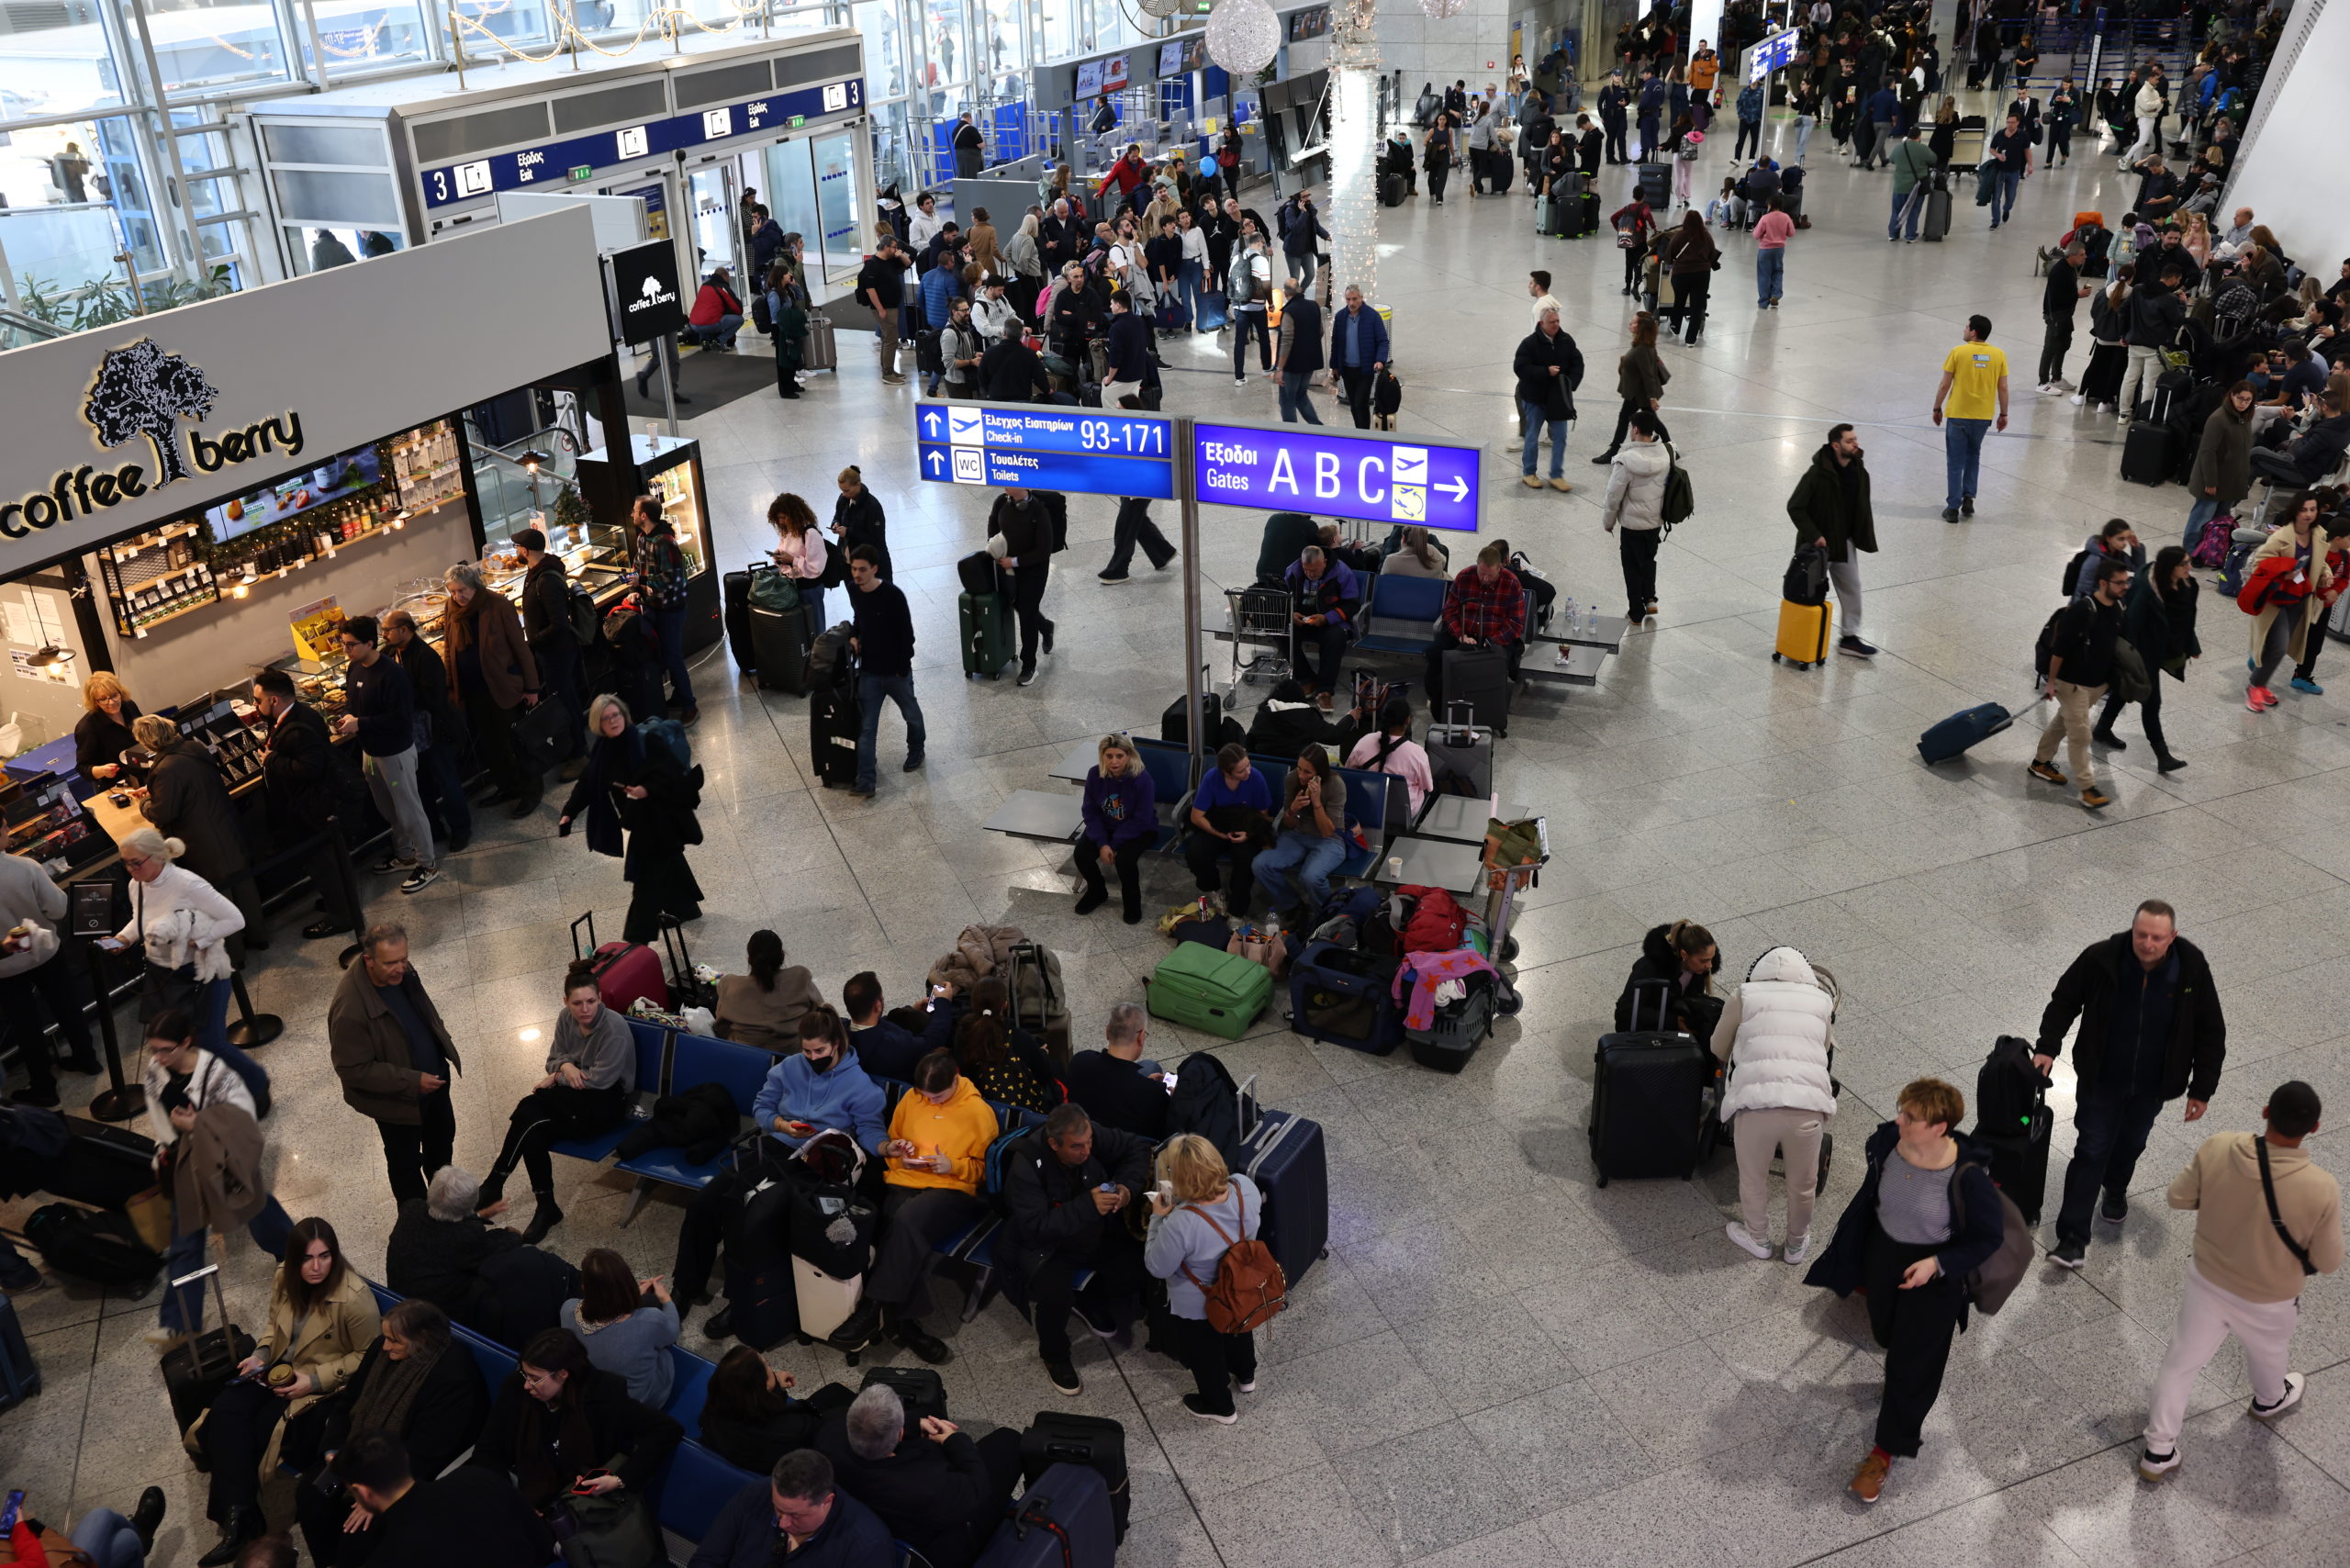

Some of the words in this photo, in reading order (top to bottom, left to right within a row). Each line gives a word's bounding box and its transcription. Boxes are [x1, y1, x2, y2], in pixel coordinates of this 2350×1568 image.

[851, 82, 859, 105] 3
[433, 171, 448, 201] 3
[520, 168, 534, 182] Exit
[628, 298, 651, 313] coffee
[655, 291, 676, 304] berry
[982, 414, 1023, 430] Έλεγχος
[986, 430, 1023, 444] Check-in
[1080, 420, 1164, 454] 93-171
[990, 453, 1038, 469] Τουαλέτες
[1201, 441, 1258, 466] Έξοδοι
[0, 465, 147, 539] coffee
[189, 411, 304, 473] berry
[959, 458, 978, 472] WC
[991, 468, 1019, 482] Toilets
[1268, 448, 1299, 495] A
[1315, 451, 1341, 498] B
[1358, 455, 1385, 504] C
[1206, 468, 1249, 490] Gates
